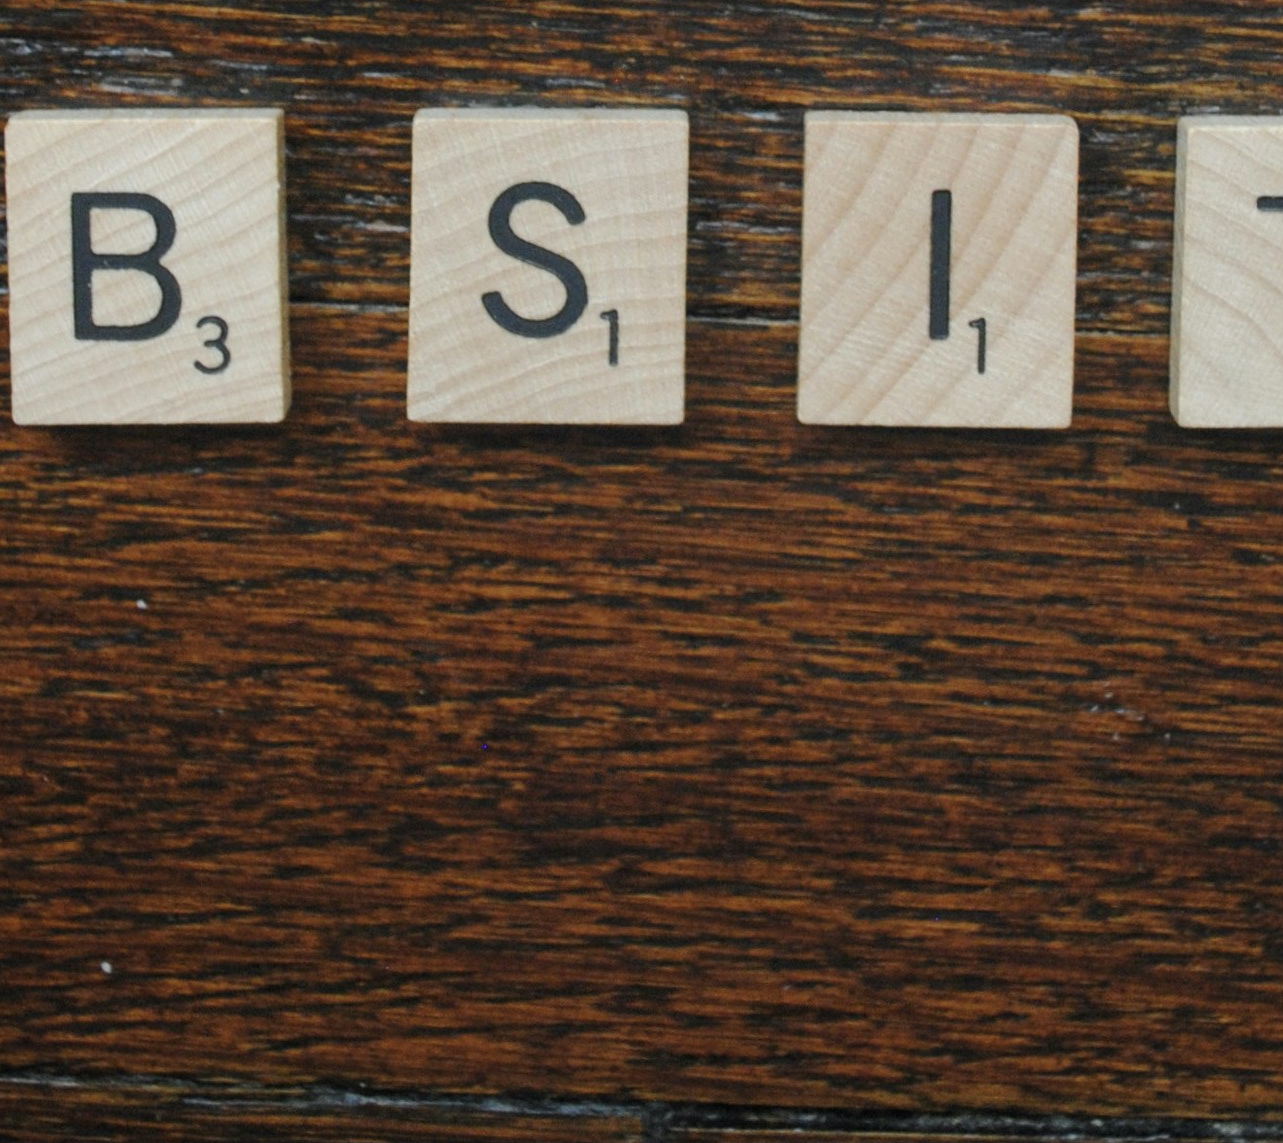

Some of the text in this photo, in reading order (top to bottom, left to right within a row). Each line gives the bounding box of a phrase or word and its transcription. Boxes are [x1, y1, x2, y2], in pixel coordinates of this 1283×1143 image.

[191, 314, 233, 376] 3
[597, 307, 621, 367] 1
[966, 316, 989, 375] 1
